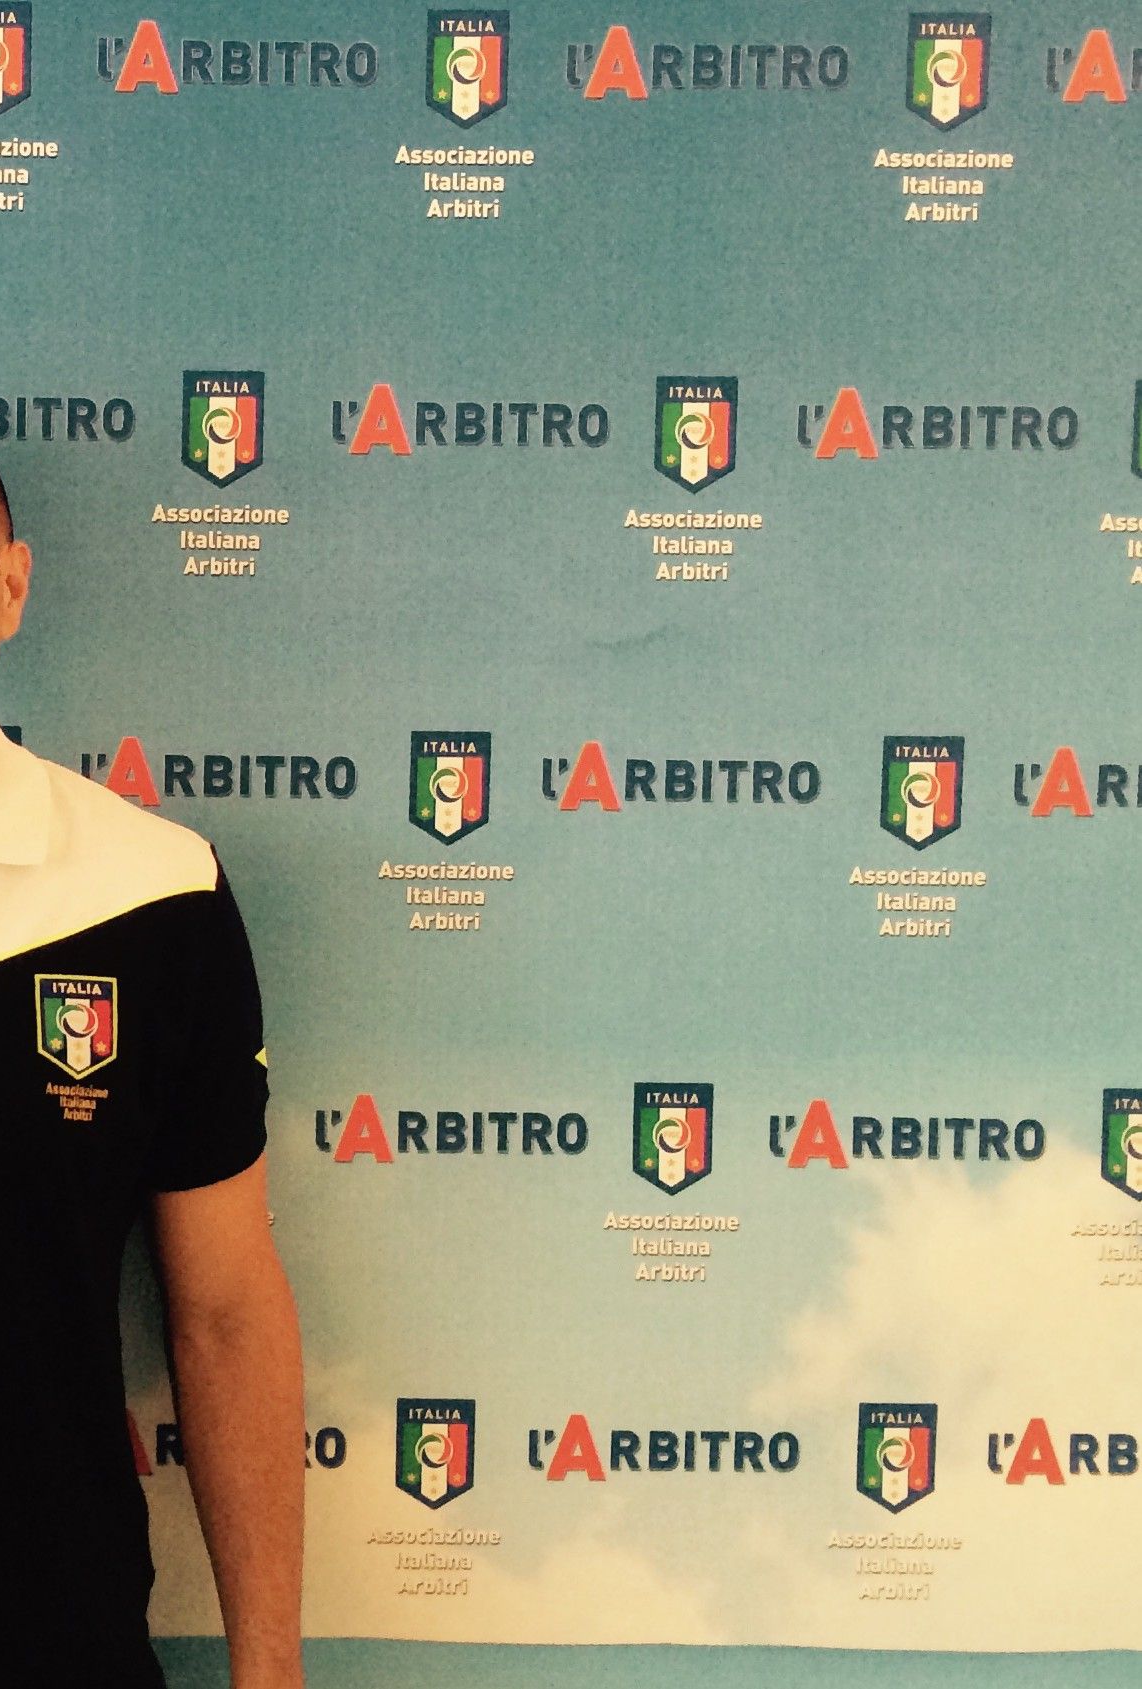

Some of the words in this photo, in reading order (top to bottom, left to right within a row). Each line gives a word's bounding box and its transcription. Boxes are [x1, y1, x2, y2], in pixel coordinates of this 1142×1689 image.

[440, 19, 496, 33] ITALIA
[921, 22, 977, 36] ITALIA
[395, 146, 534, 167] Associazione
[874, 149, 1013, 170] Associazione
[423, 172, 504, 194] Italiana
[902, 175, 984, 197] Italiana
[427, 198, 500, 219] Arbitri
[905, 202, 979, 223] Arbitri
[196, 381, 249, 393] ITALIA
[669, 387, 723, 399] ITALIA
[151, 504, 289, 525] Associazione
[624, 510, 762, 530] Associazione
[180, 530, 260, 551] Italiana
[652, 536, 733, 556] Italiana
[184, 557, 255, 577] Arbitri
[656, 562, 728, 582] Arbitri
[423, 740, 477, 754] ITALIA
[896, 745, 950, 758] ITALIA
[378, 860, 514, 881] Associazione
[849, 866, 987, 888] Associazione
[406, 886, 486, 906] Italiana
[877, 892, 957, 913] Italiana
[409, 911, 480, 932] Arbitri
[879, 917, 952, 938] Arbitri
[52, 982, 102, 995] ITALIA
[45, 1082, 109, 1098] Associazione
[646, 1092, 699, 1104] ITALIA
[59, 1096, 97, 1110] Italiana
[63, 1108, 93, 1121] Arbitri
[603, 1210, 739, 1233] Associazione
[631, 1236, 711, 1257] Italiana
[635, 1262, 705, 1283] Arbitri
[408, 1408, 461, 1420] ITALIA
[870, 1412, 924, 1425] ITALIA
